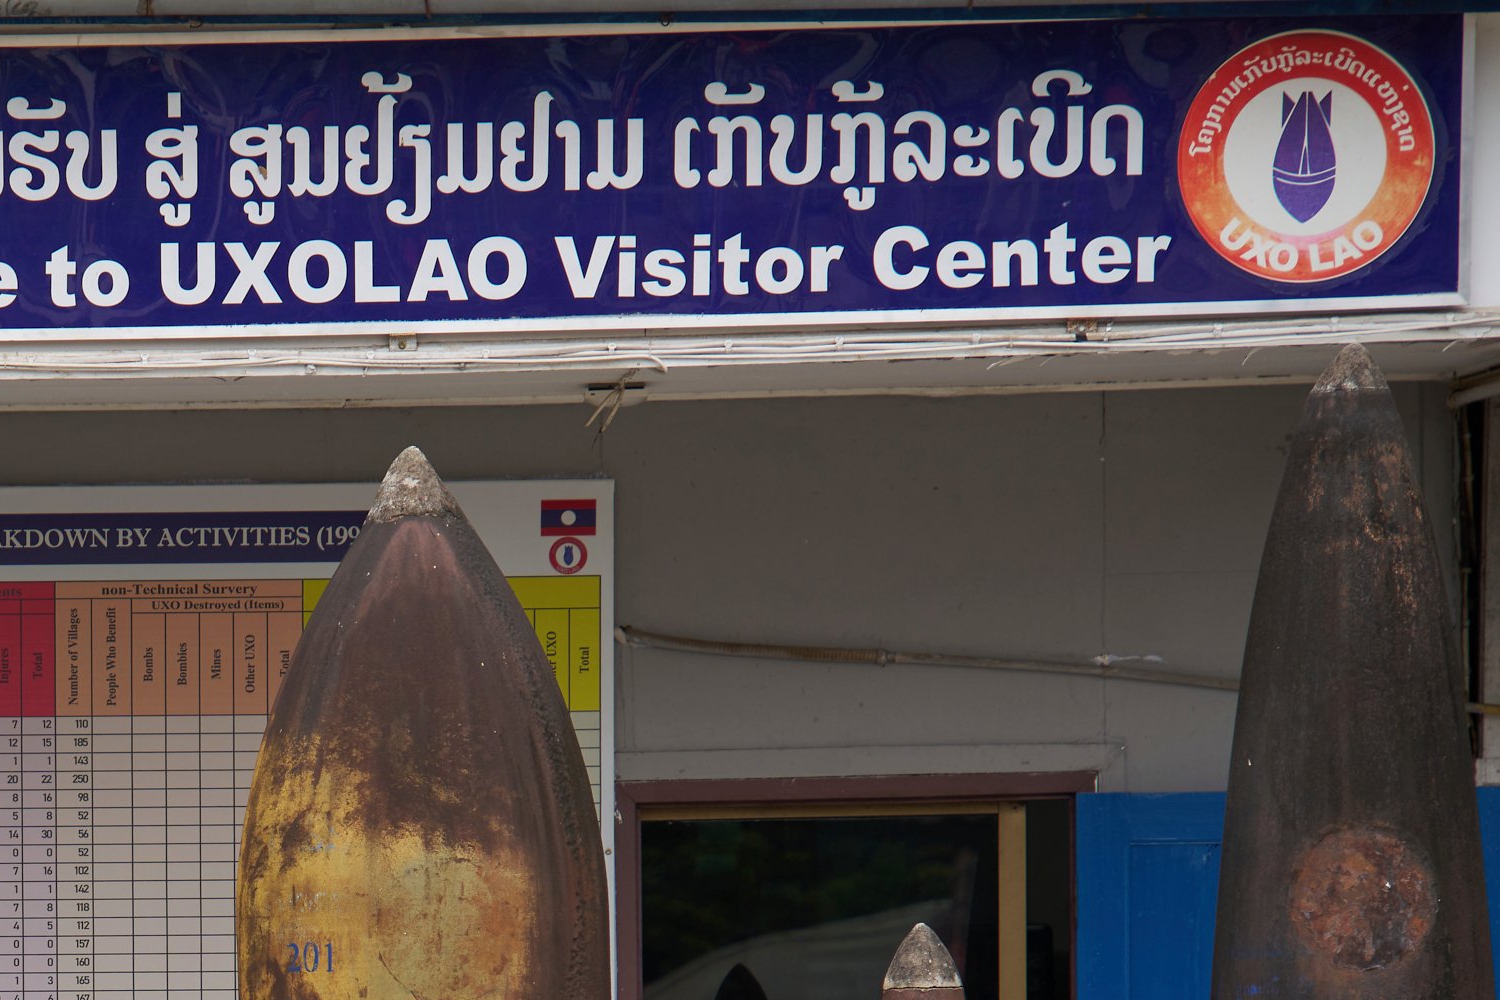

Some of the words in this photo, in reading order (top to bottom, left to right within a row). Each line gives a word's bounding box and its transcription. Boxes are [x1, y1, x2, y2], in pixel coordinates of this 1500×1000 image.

[145, 92, 199, 227] ສູ່
[229, 71, 644, 225] ສູນຢ້ຽມຢາມ
[674, 69, 1144, 211] ເກັບກູ້ລະເບີດ
[1218, 216, 1299, 274] UXO
[1310, 219, 1385, 273] LAO
[46, 245, 130, 308] to
[160, 236, 528, 304] UXOLAO
[555, 232, 843, 299] Visitor
[874, 222, 1173, 291] Center
[116, 527, 153, 548] BY
[158, 525, 311, 548] ACTIVITIES
[101, 584, 198, 596] non-Technical
[202, 583, 258, 597] Survery
[151, 600, 180, 610] UXO
[184, 600, 240, 612] Destroyed
[243, 599, 285, 611] (Items)
[68, 608, 80, 657] Villages
[106, 607, 116, 646] Benefit
[245, 634, 255, 658] UXO
[546, 631, 557, 657] UXO
[0, 647, 11, 684] Injures
[33, 651, 43, 679] Total
[68, 658, 78, 670] of
[106, 648, 116, 672] Who
[143, 647, 154, 683] Bombs
[177, 642, 188, 686] Bombies
[211, 648, 222, 679] Mines
[579, 647, 590, 673] Total
[68, 672, 78, 705] Number
[106, 675, 118, 706] People
[245, 659, 255, 693] Other
[286, 941, 335, 973] 201
